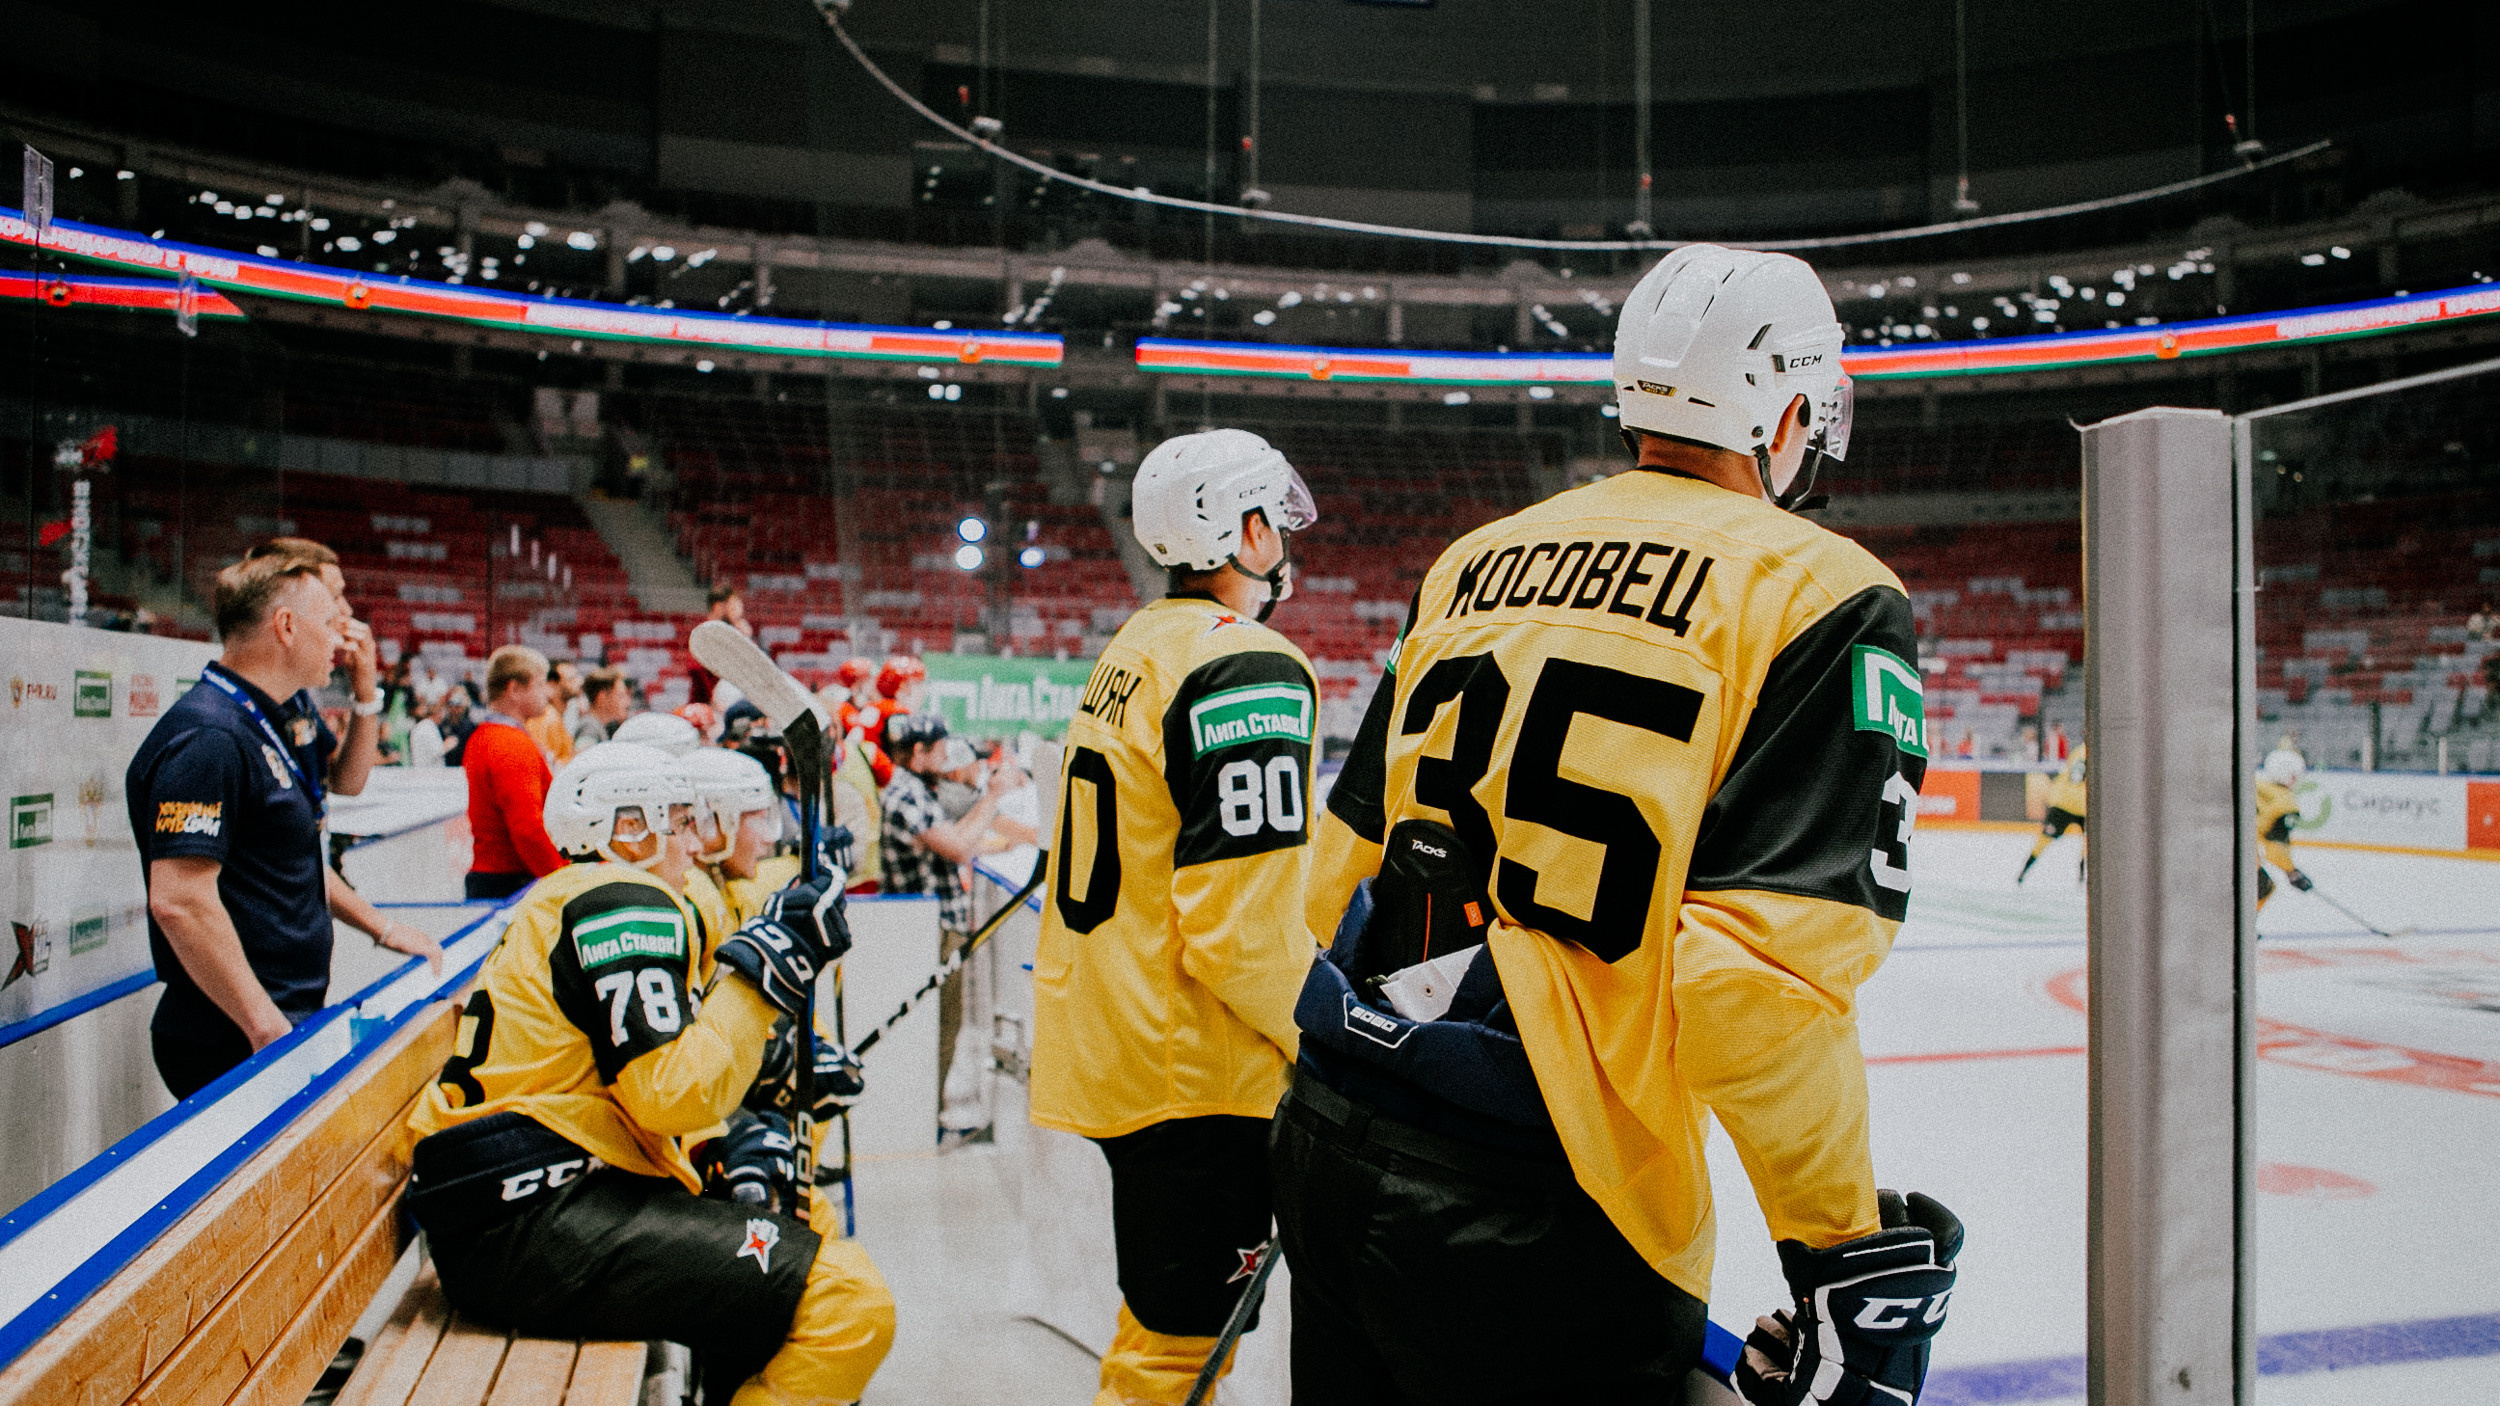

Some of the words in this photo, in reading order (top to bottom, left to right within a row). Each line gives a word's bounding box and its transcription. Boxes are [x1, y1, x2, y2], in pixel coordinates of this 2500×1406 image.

[1790, 354, 1822, 368] CCM
[1239, 485, 1266, 498] CCM
[1445, 542, 1715, 638] КОСОВЕЦ
[1204, 719, 1250, 747] ЛИГА
[1218, 756, 1304, 837] 80
[1401, 650, 1705, 964] 35
[1870, 771, 1919, 893] 3
[1056, 746, 1121, 935] 0
[1412, 840, 1447, 858] TACKS
[581, 938, 621, 967] ЛИГА
[619, 931, 675, 954] СТАВОК
[595, 968, 681, 1048] 78
